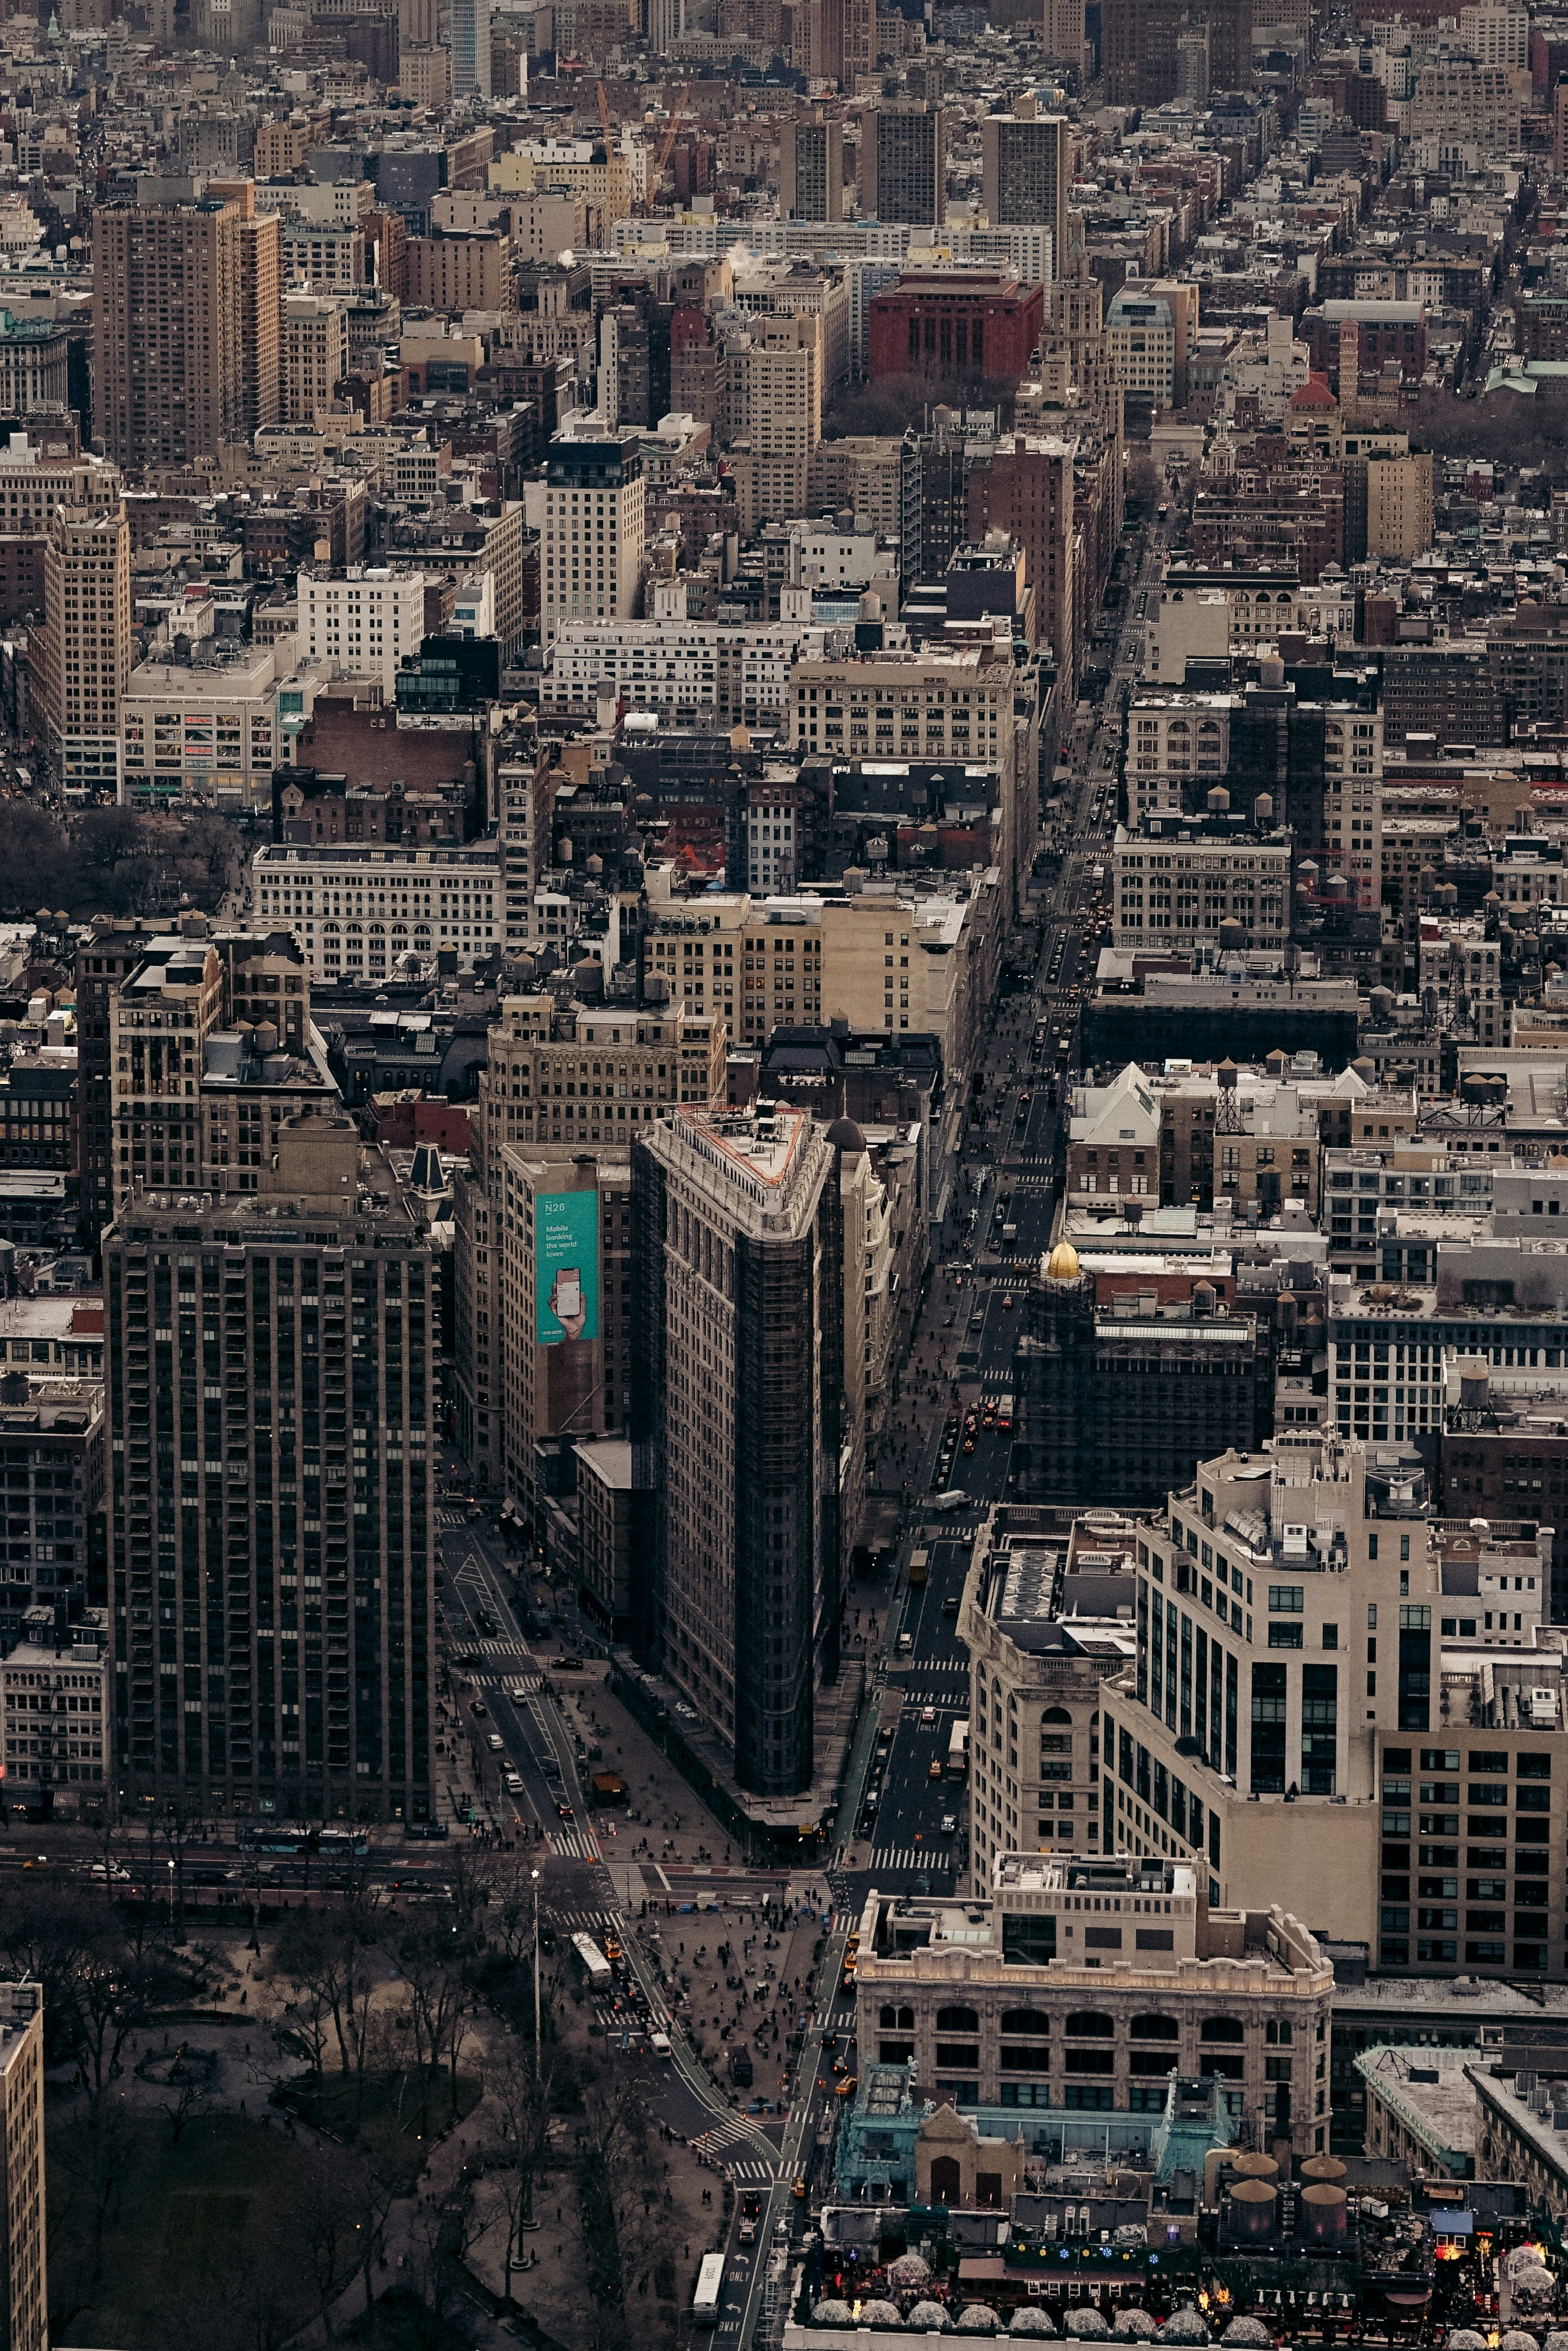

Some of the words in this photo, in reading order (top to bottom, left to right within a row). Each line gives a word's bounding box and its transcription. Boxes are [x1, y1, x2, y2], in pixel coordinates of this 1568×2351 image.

[545, 1202, 565, 1213] N26
[729, 2271, 750, 2282] ONLY
[718, 2321, 740, 2332] BWAY
